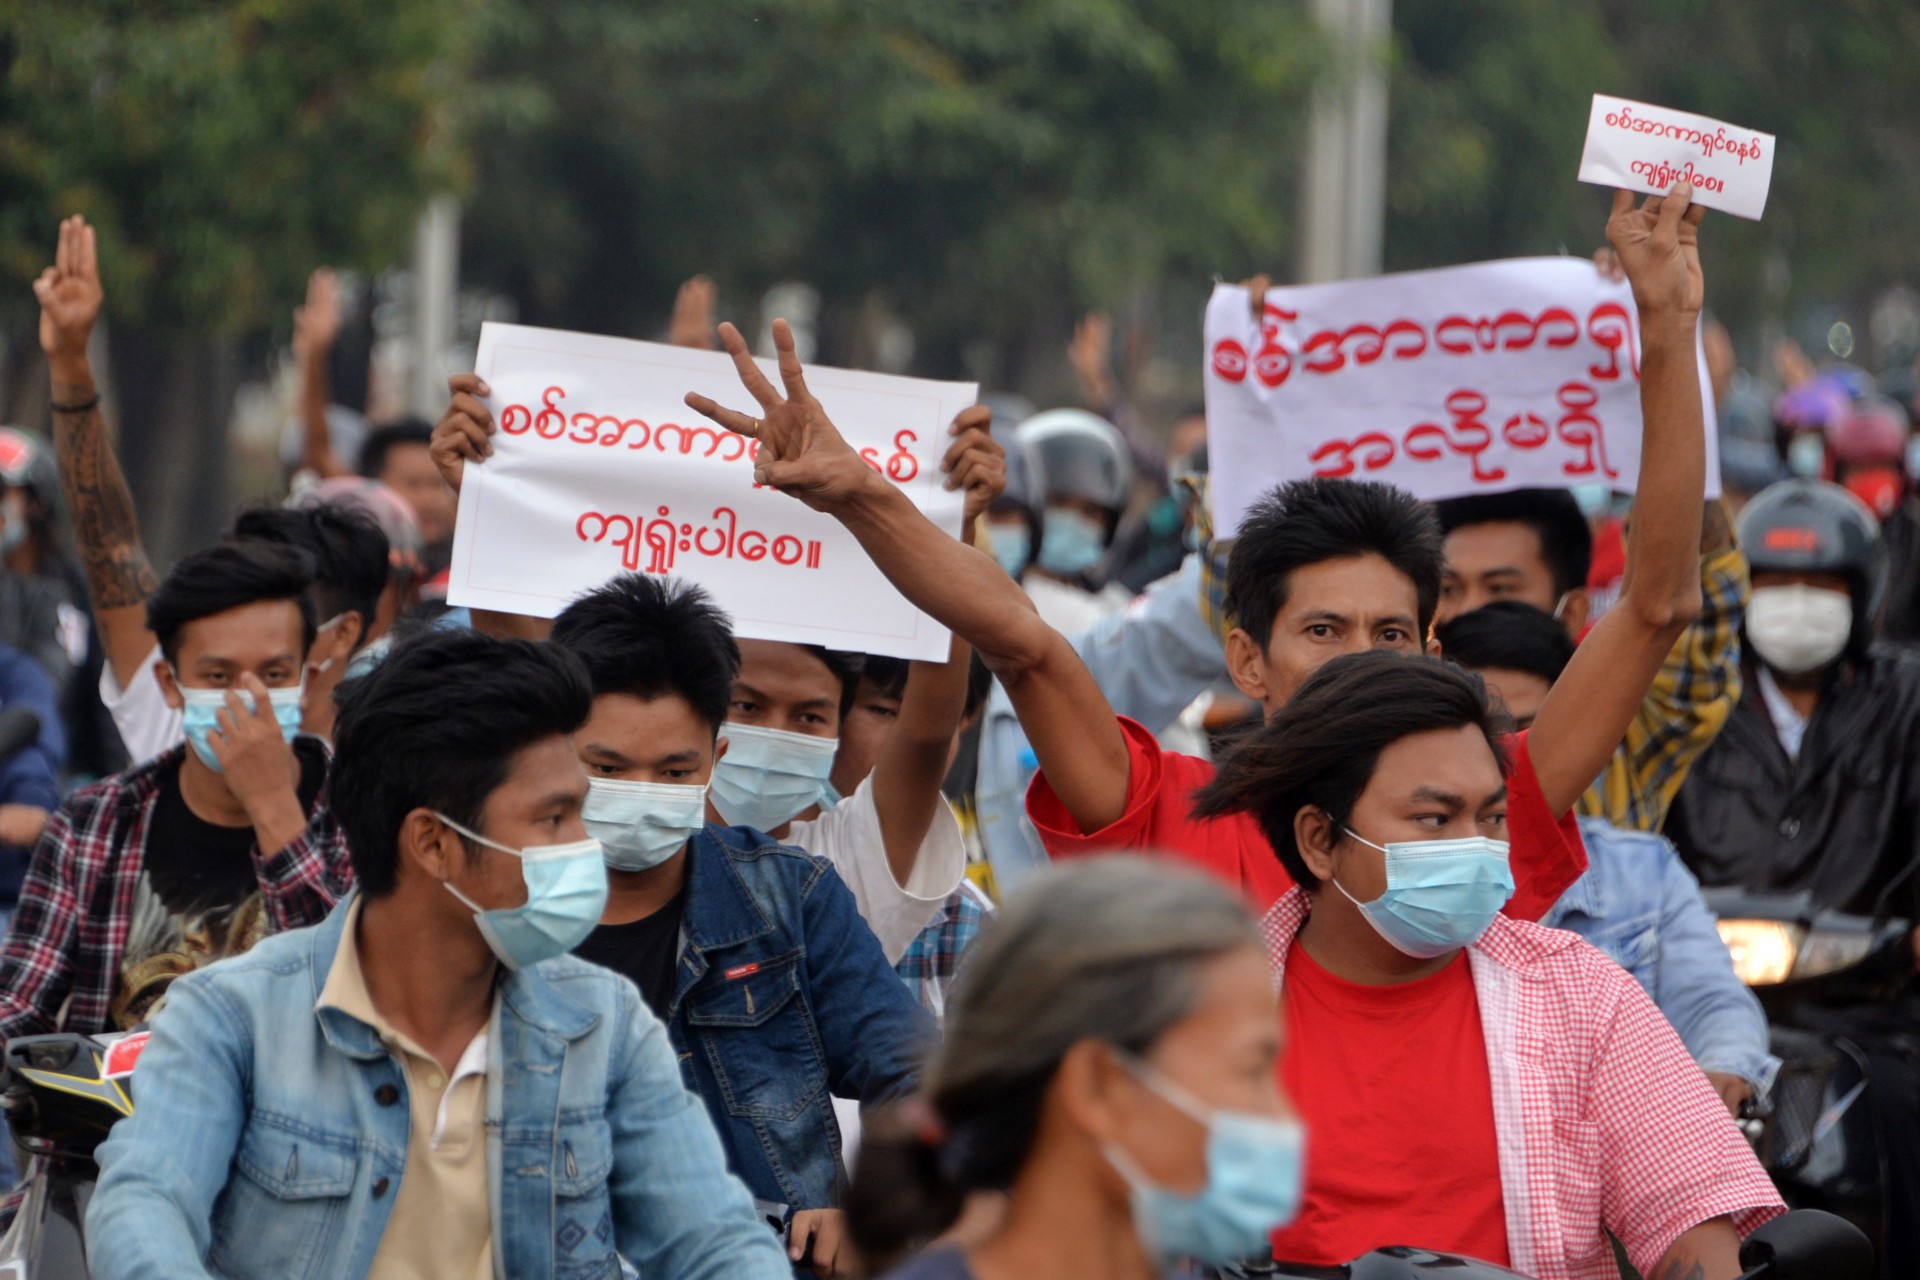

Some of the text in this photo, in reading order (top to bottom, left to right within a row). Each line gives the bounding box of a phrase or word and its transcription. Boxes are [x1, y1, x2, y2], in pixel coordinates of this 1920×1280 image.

[1604, 107, 1761, 164] စစ်အာဏာရှင်စနစ်
[1211, 301, 1643, 390] စစ်အာဏာရှ
[1309, 381, 1620, 484] အလိုမရှိ
[575, 504, 822, 575] ကျရှုံးပါစေ။
